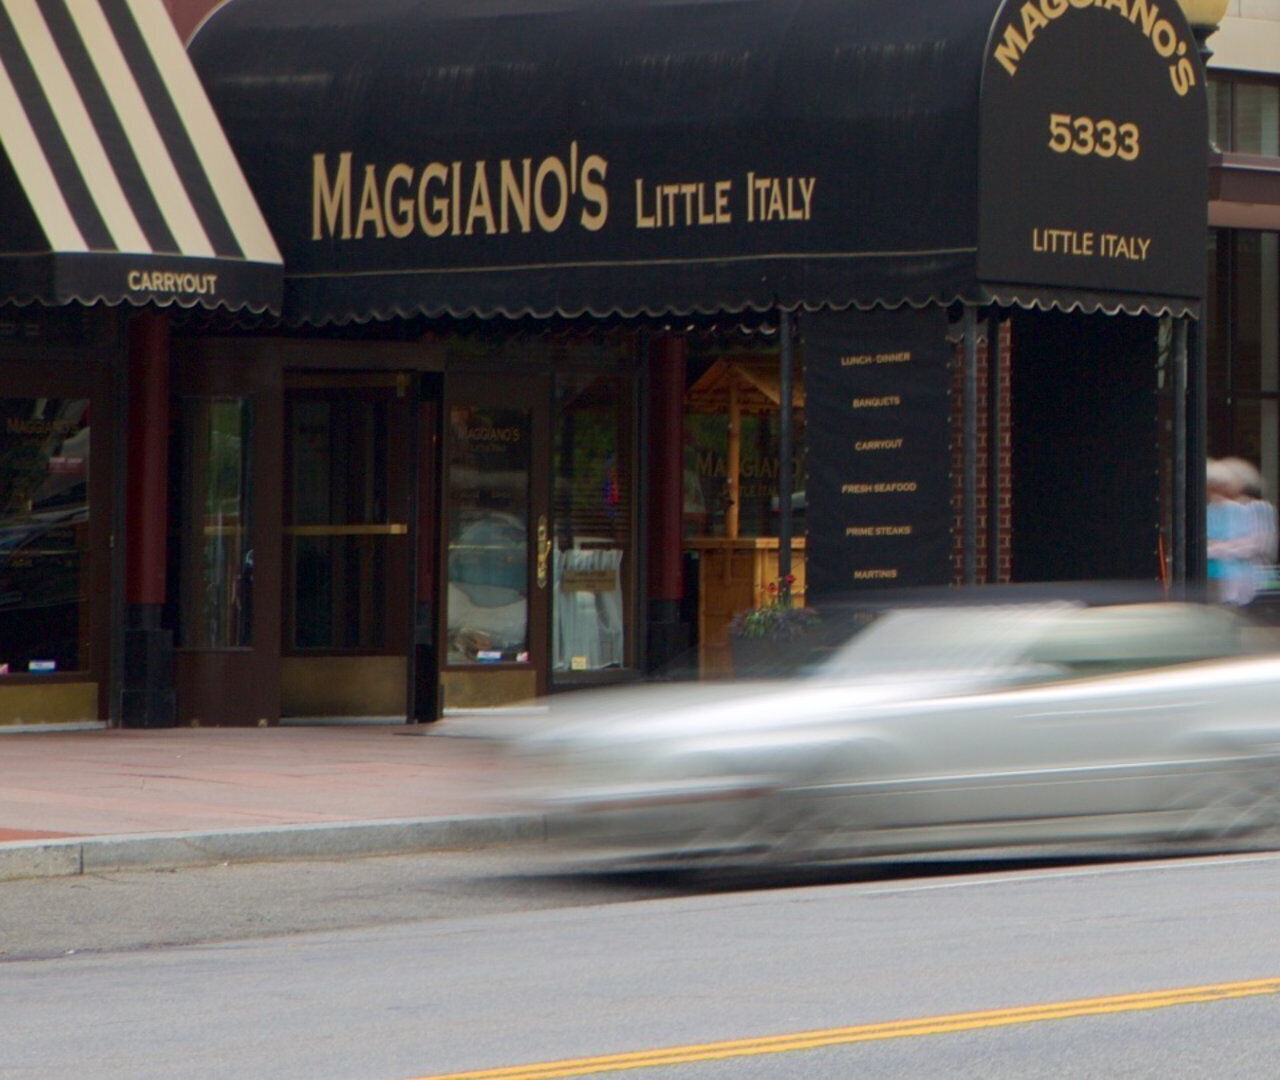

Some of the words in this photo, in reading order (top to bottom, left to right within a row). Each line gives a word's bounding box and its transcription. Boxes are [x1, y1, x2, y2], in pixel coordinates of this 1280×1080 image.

[1048, 113, 1140, 161] 5333
[311, 139, 609, 241] MAGGIANO'S
[635, 177, 732, 229] LITTLE
[747, 171, 816, 222] ITALY
[1032, 227, 1093, 255] LITTLE
[1100, 233, 1151, 260] ITALY
[127, 271, 218, 295] CARRYOUT
[852, 395, 901, 409] BANQUETS
[854, 438, 904, 452] CARRYOUT
[841, 484, 873, 494] FRESH
[873, 482, 917, 493] SEAFOOD
[845, 526, 875, 536] PRIME
[875, 525, 912, 536] STEAKS
[853, 569, 898, 580] MARTINIS
